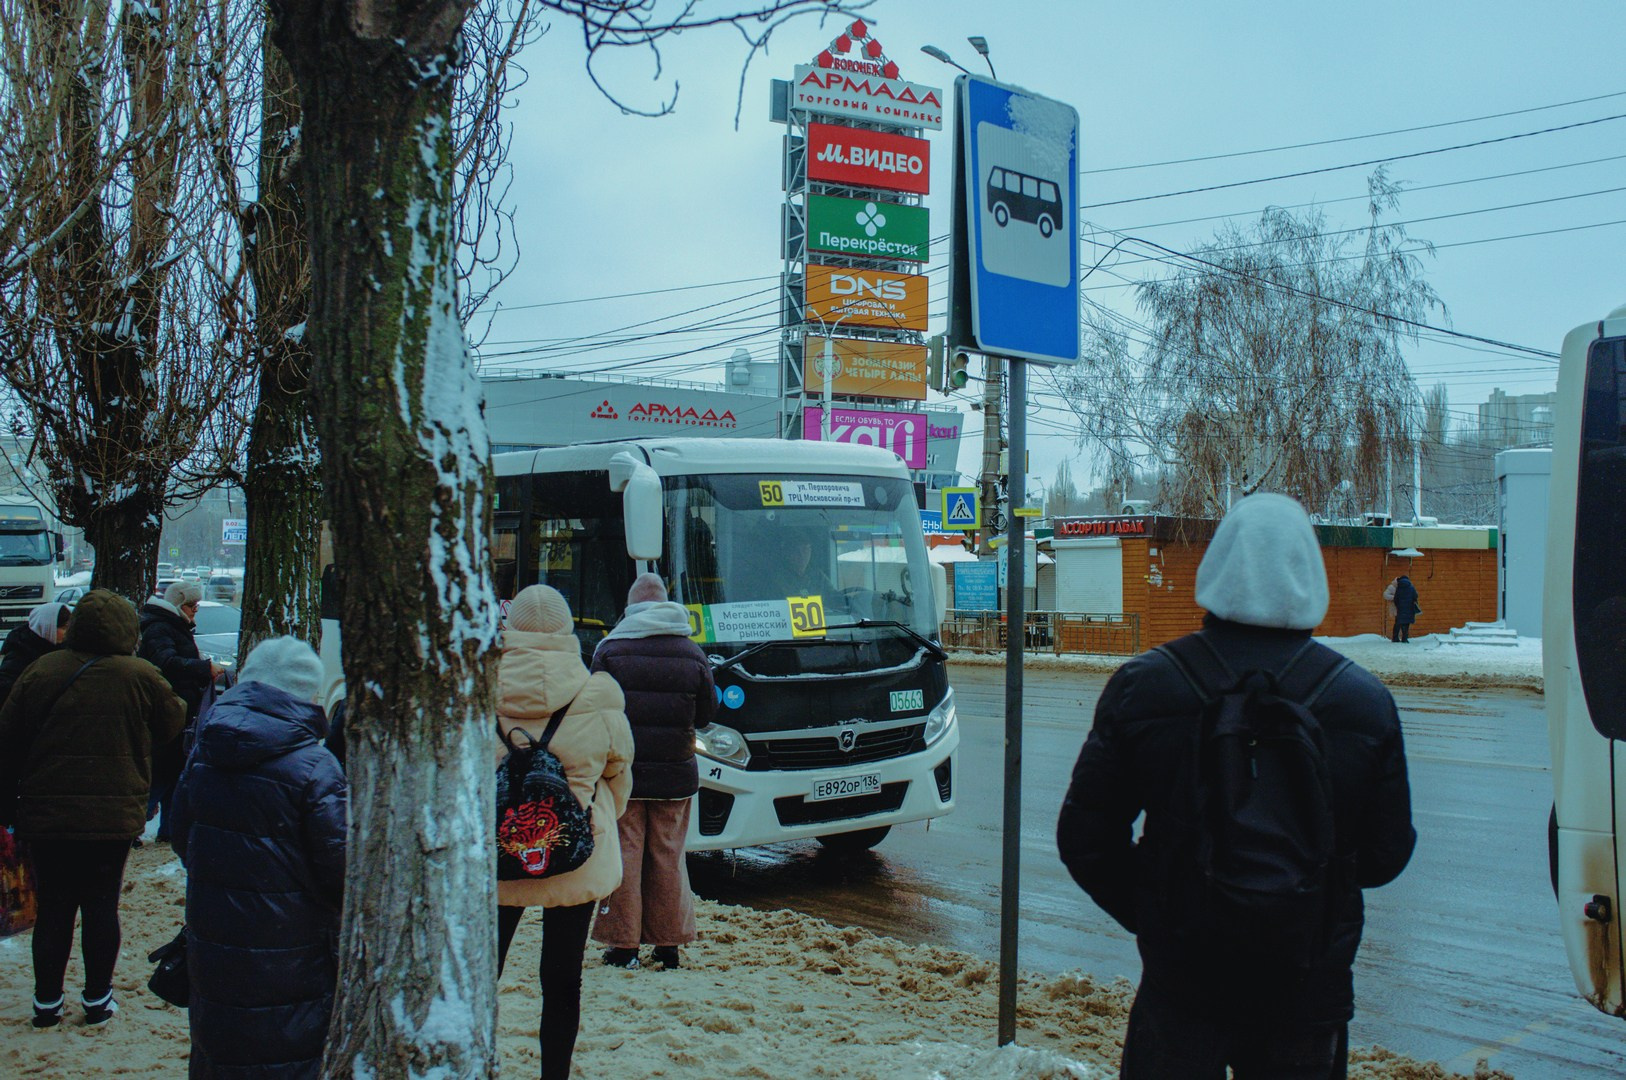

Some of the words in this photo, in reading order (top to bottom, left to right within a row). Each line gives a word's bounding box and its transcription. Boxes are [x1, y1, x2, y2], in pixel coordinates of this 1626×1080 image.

[834, 58, 880, 76] ВОРОНЕЖ
[800, 71, 941, 108] АРМАДА
[799, 94, 868, 111] ТОРГОВЫЙ
[876, 105, 941, 123] КОМПЛЕКС
[817, 143, 922, 174] М.ВИДЕО
[820, 232, 918, 256] Перекрёсток
[830, 274, 906, 301] DNS
[842, 298, 887, 309] ЦИФРОВАЯ
[830, 305, 869, 316] БЫТОВАЯ
[871, 309, 906, 320] ТЕХНИКА
[851, 357, 917, 371] ЗООМАГАЗИН
[845, 367, 887, 380] ЧЕТЫРЕ
[890, 371, 922, 383] ЛАПЫ
[628, 415, 680, 424] ТОРГОВЫЙ
[629, 402, 736, 421] АРМАДА
[835, 415, 856, 424] ЕСЛИ
[857, 418, 883, 427] ОБУВЬ,
[821, 415, 915, 462] kari
[929, 424, 958, 439] kari
[761, 484, 783, 503] 50
[797, 484, 808, 492] ул.
[809, 483, 851, 493] Перхоровича
[788, 494, 803, 503] ТРЦ
[804, 494, 842, 503] Московский
[1060, 521, 1106, 535] АССОРТИ
[1108, 520, 1145, 533] ТАБАК
[722, 609, 781, 620] Мегашкола
[791, 601, 823, 631] 50
[718, 618, 788, 633] Воронежский
[739, 629, 771, 640] рынок
[891, 691, 923, 710] 05663
[818, 780, 860, 796] Е892ОР
[863, 776, 878, 787] 136
